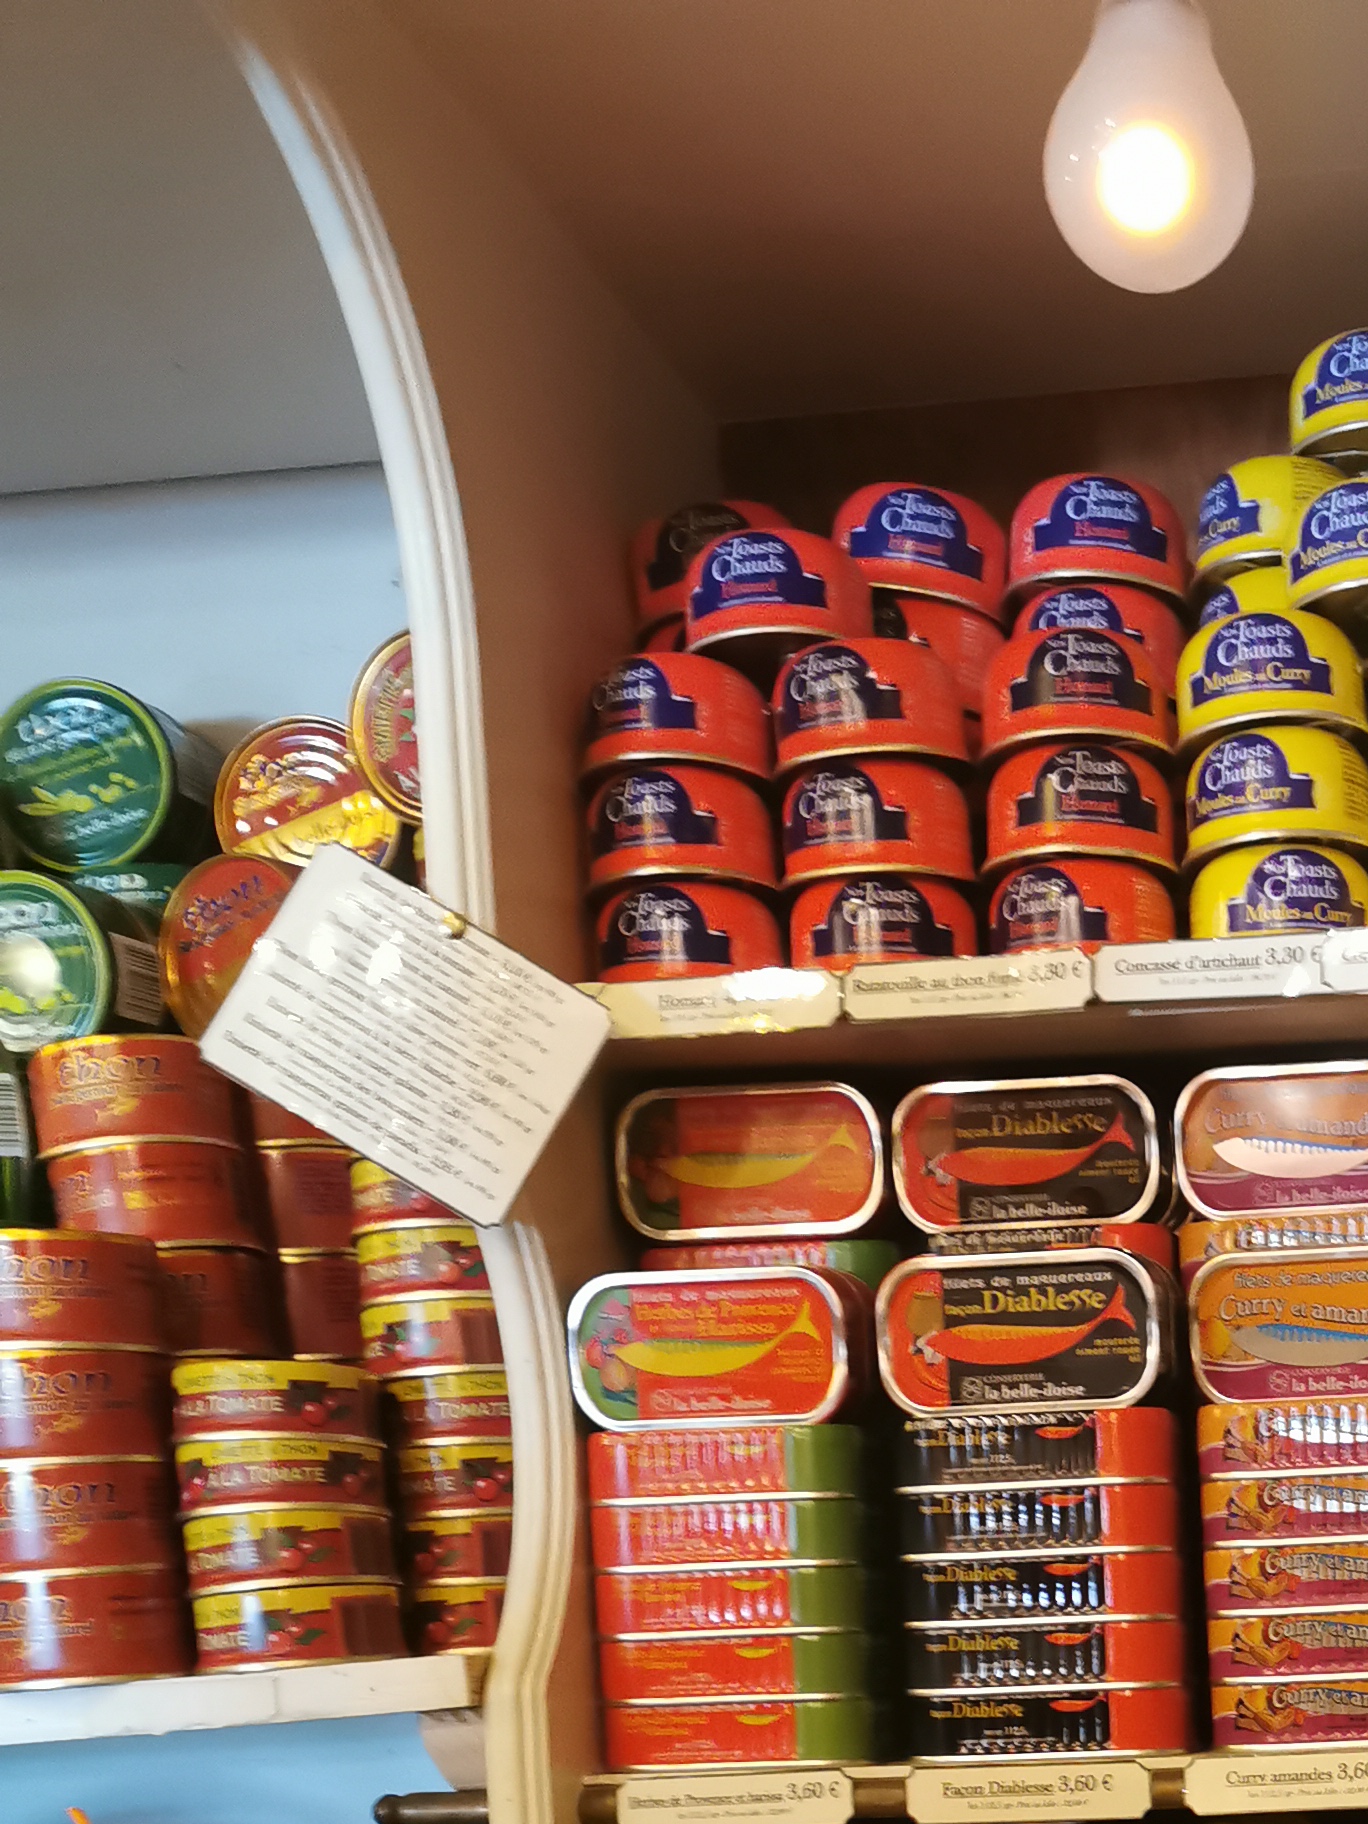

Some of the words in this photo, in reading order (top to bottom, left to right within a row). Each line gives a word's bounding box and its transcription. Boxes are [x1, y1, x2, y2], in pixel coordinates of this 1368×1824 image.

[1237, 619, 1292, 641] Toasts
[1217, 640, 1295, 667] Chauds
[1266, 661, 1312, 684] Curry
[982, 1287, 1107, 1315] Diablesse
[1218, 1295, 1286, 1321] Curry
[1290, 1301, 1307, 1318] et
[988, 1777, 1055, 1795] Diablesse
[1057, 1776, 1096, 1793] 3,60
[1101, 1775, 1114, 1791] €
[1225, 1770, 1266, 1788] Curry
[1269, 1767, 1334, 1783] amandes
[828, 1781, 840, 1799] €
